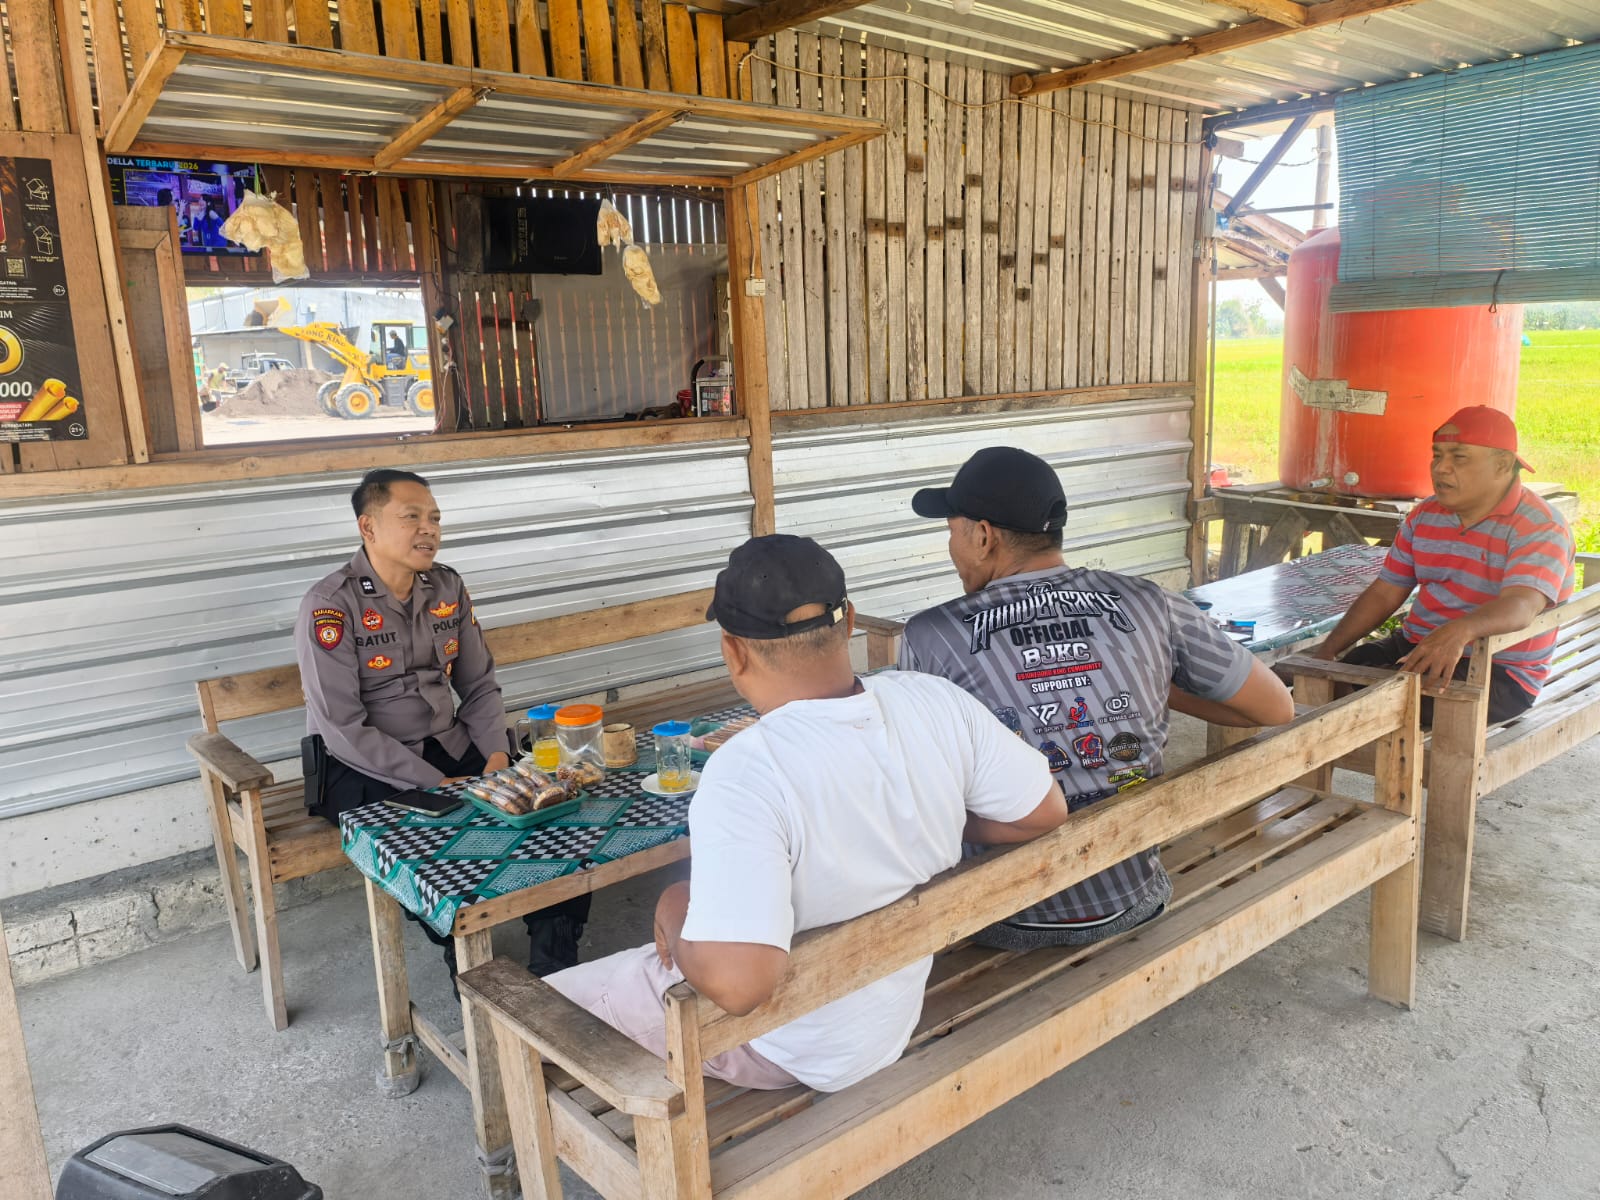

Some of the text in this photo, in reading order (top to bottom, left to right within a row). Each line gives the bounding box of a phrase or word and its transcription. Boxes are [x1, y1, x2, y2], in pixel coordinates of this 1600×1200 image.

[136, 159, 175, 169] TERBARU
[355, 632, 397, 647] GATUT
[1010, 619, 1094, 647] OFFICIAL
[1021, 641, 1091, 670] BJKC
[1031, 676, 1092, 694] SUPPORT BY:
